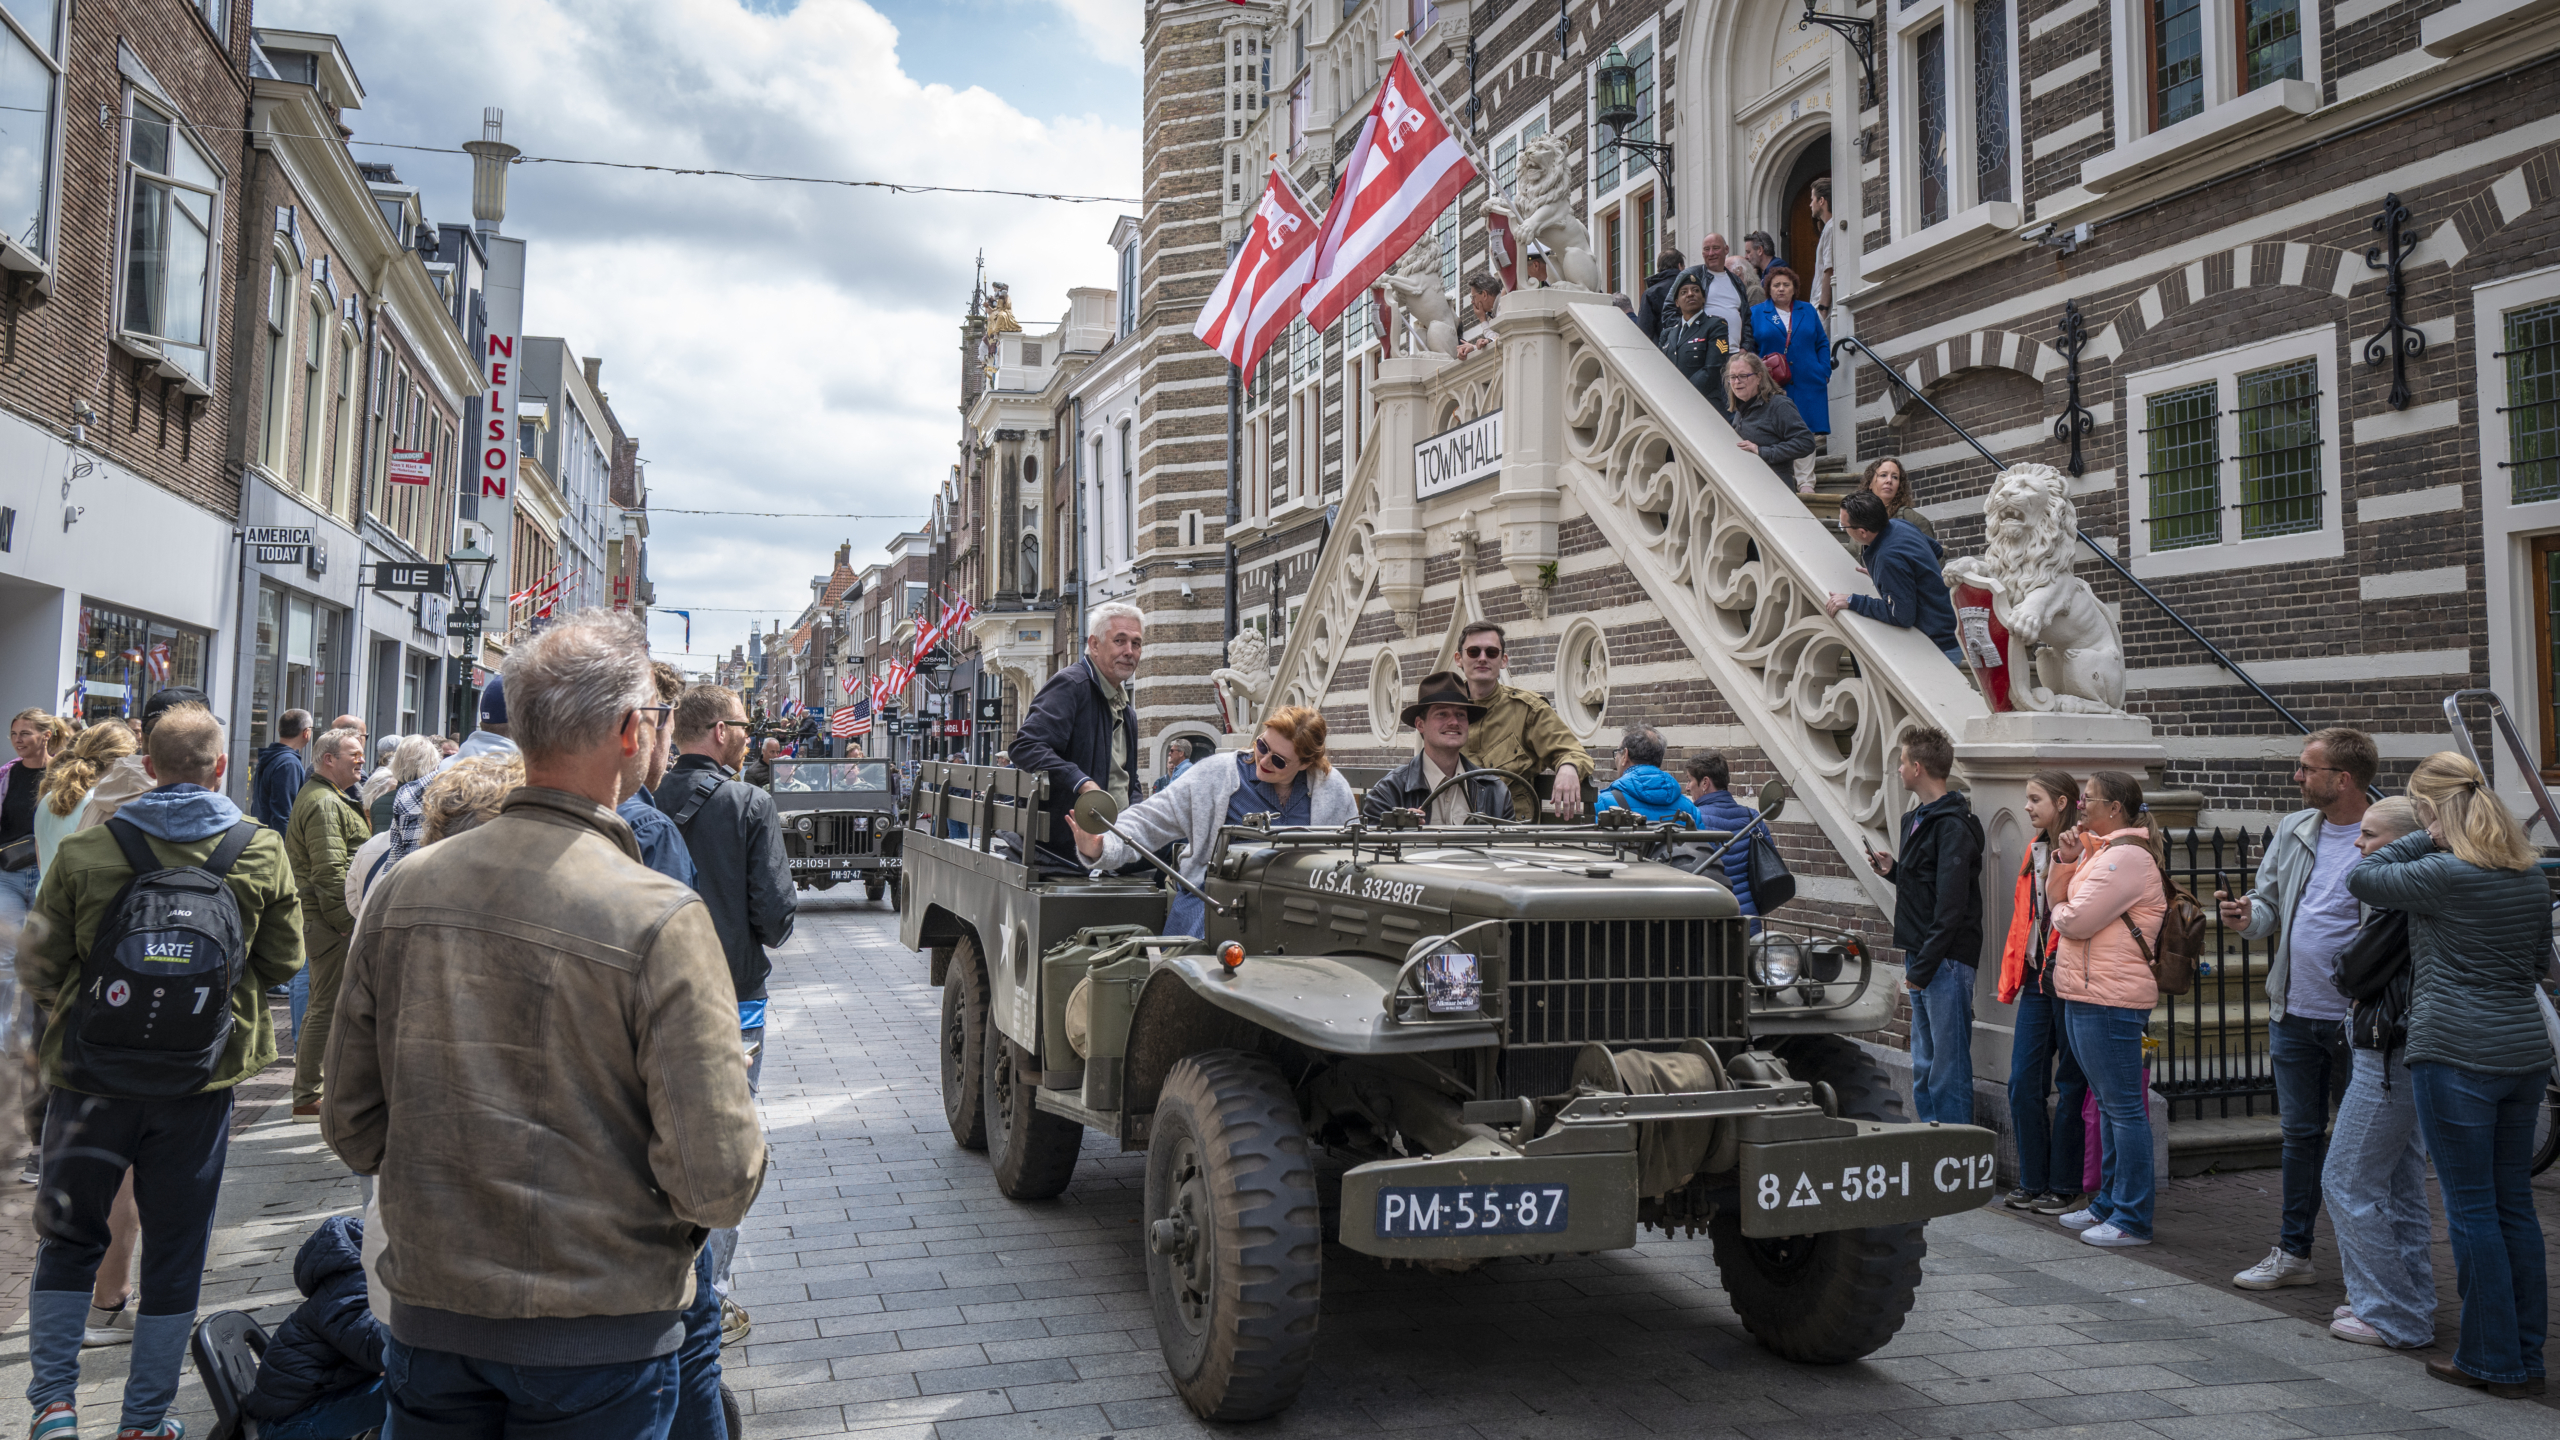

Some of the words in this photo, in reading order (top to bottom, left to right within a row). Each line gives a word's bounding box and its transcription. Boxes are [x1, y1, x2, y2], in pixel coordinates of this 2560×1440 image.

[482, 334, 513, 499] NELSON
[1419, 420, 1502, 487] TOWNHALL
[247, 528, 311, 543] AMERICA
[259, 546, 298, 561] TODAY
[392, 569, 429, 585] WE
[831, 870, 861, 879] PM-97-47
[1309, 869, 1355, 895] U.S.A.
[1362, 877, 1425, 905] 332987
[192, 987, 210, 1014] 7
[1934, 1154, 1994, 1193] C12
[1385, 1190, 1563, 1231] PM-55-87
